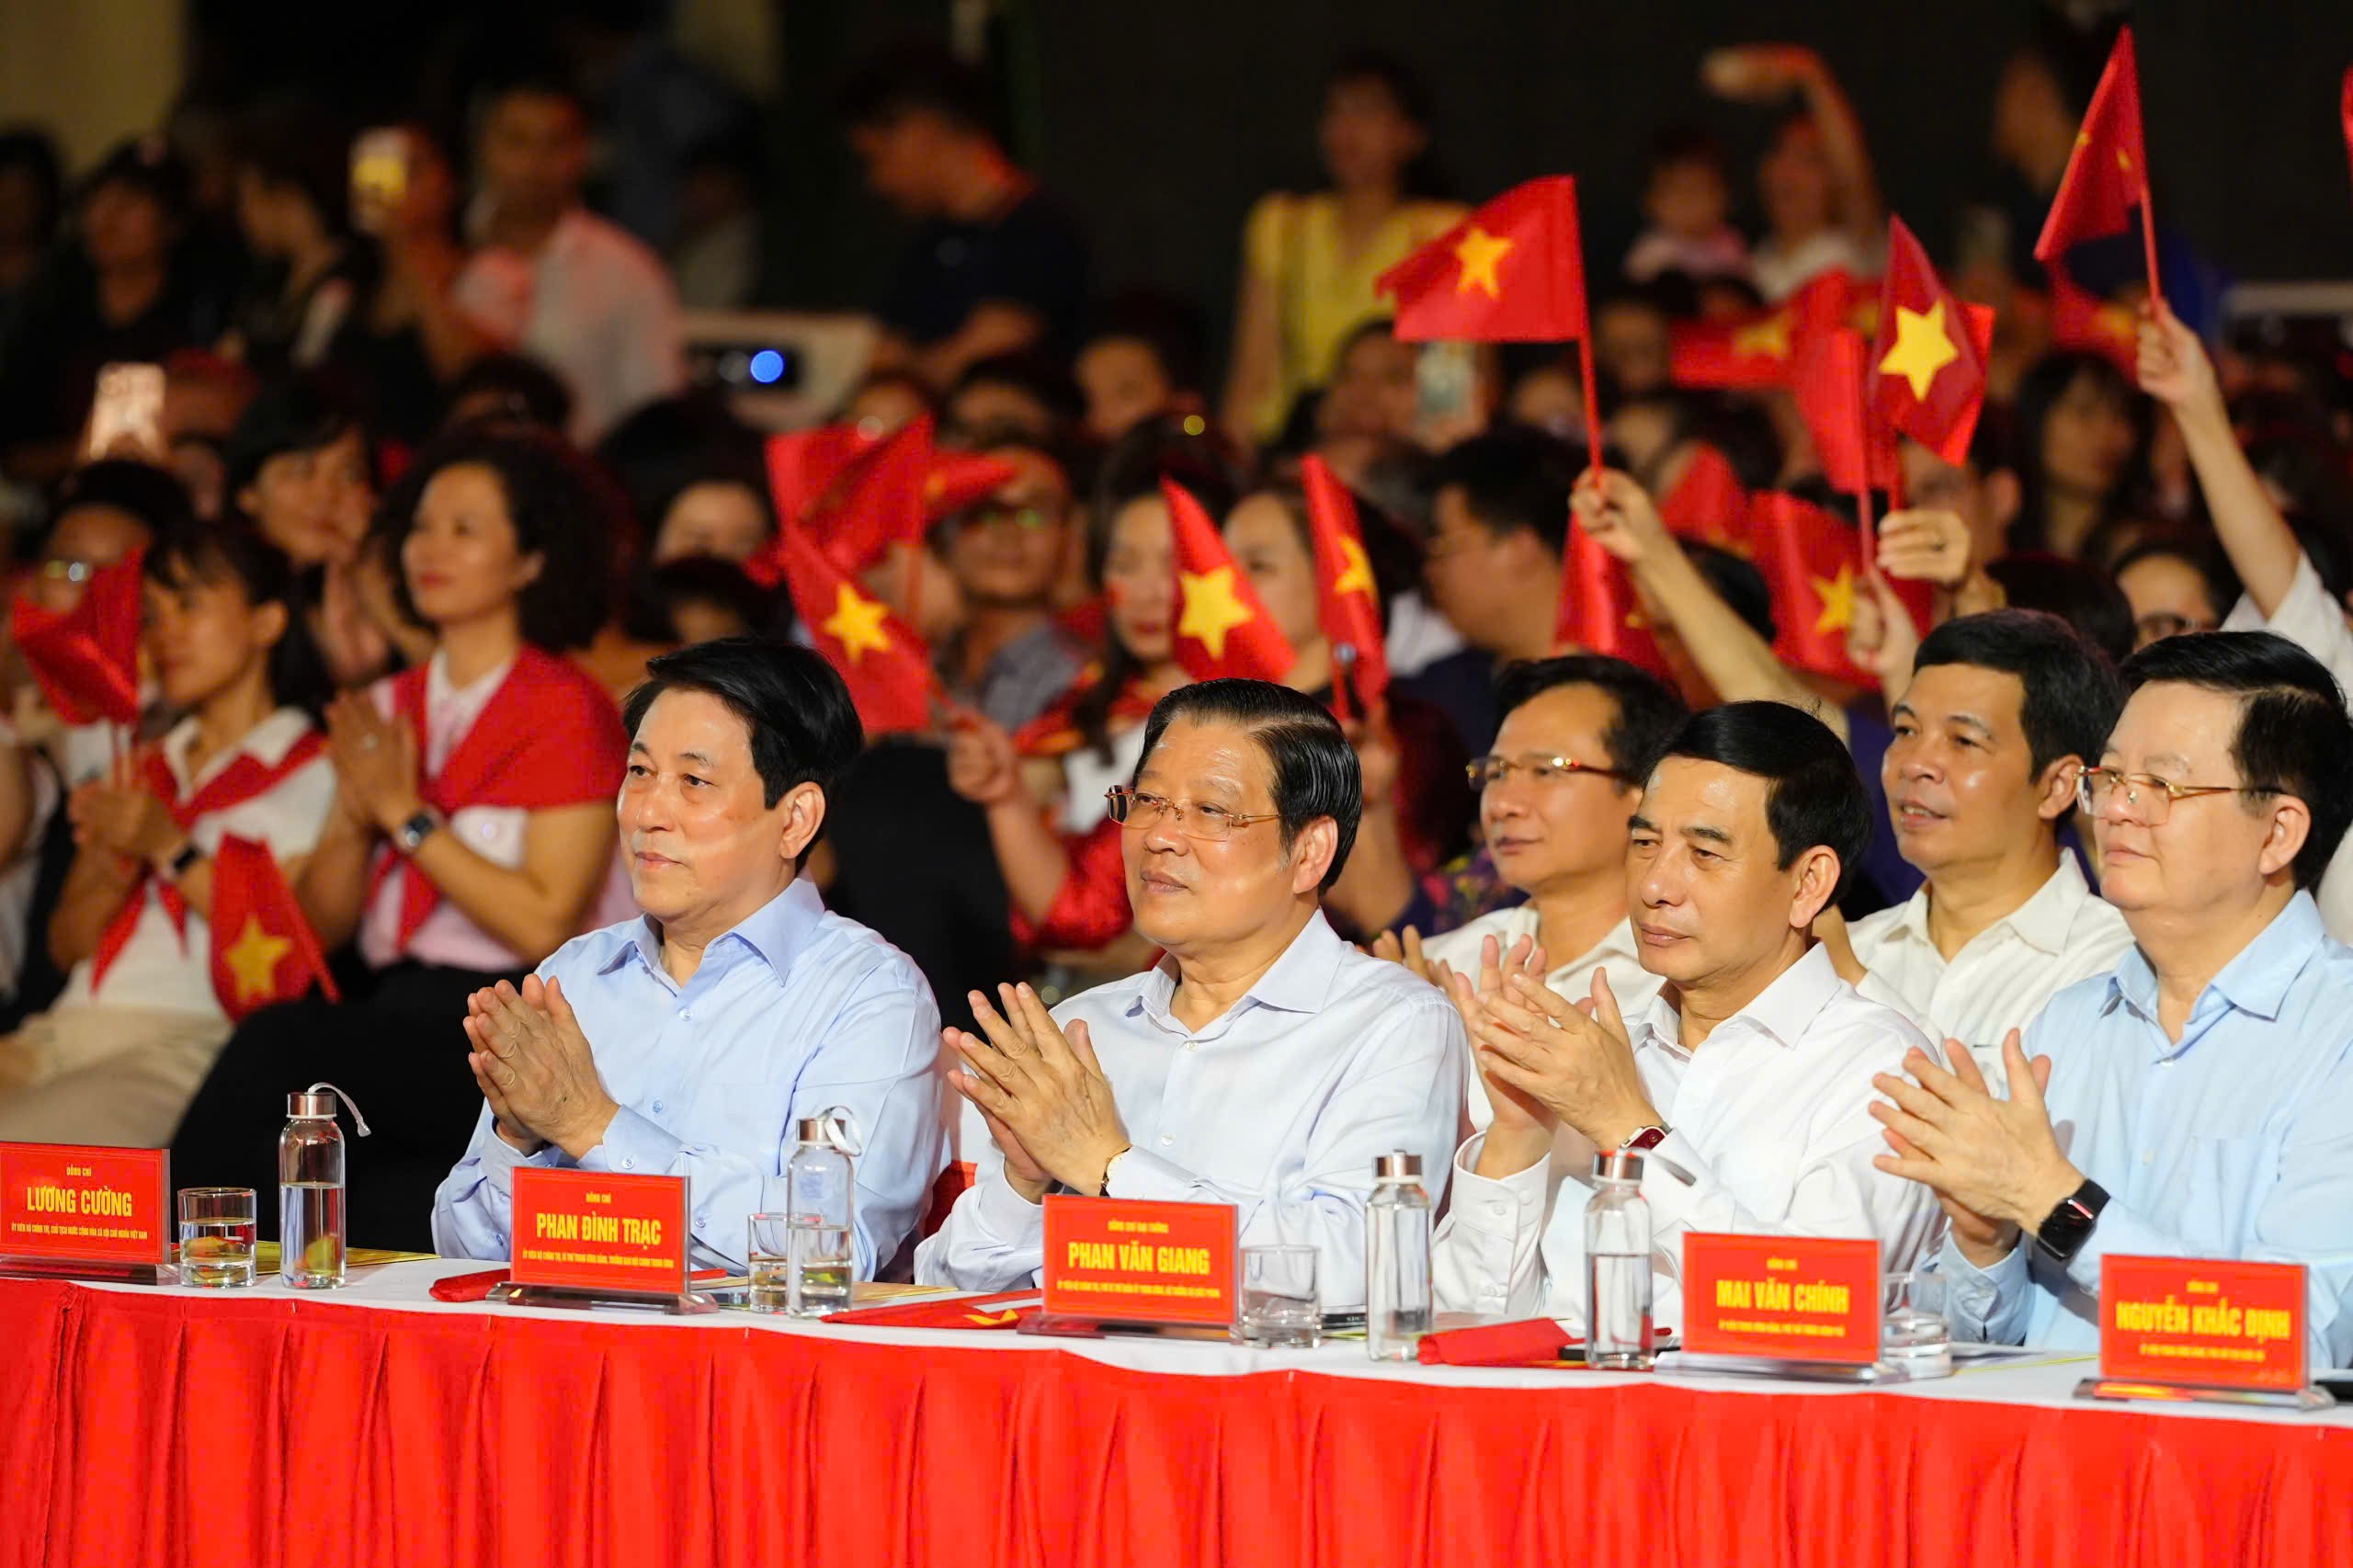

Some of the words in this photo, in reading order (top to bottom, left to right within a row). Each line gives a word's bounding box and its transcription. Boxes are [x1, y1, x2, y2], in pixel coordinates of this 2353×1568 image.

[27, 1186, 75, 1213] LƯƠNG
[80, 1186, 132, 1217] CƯỜNG
[536, 1212, 578, 1240] PHAN
[582, 1210, 619, 1243] ĐÌNH
[622, 1218, 662, 1250] TRẠC
[1068, 1242, 1115, 1269] PHAN
[1119, 1240, 1153, 1271] VĂN
[1157, 1246, 1211, 1276] GIANG
[1716, 1279, 1751, 1309] MAI
[1794, 1279, 1849, 1314] CHÍNH
